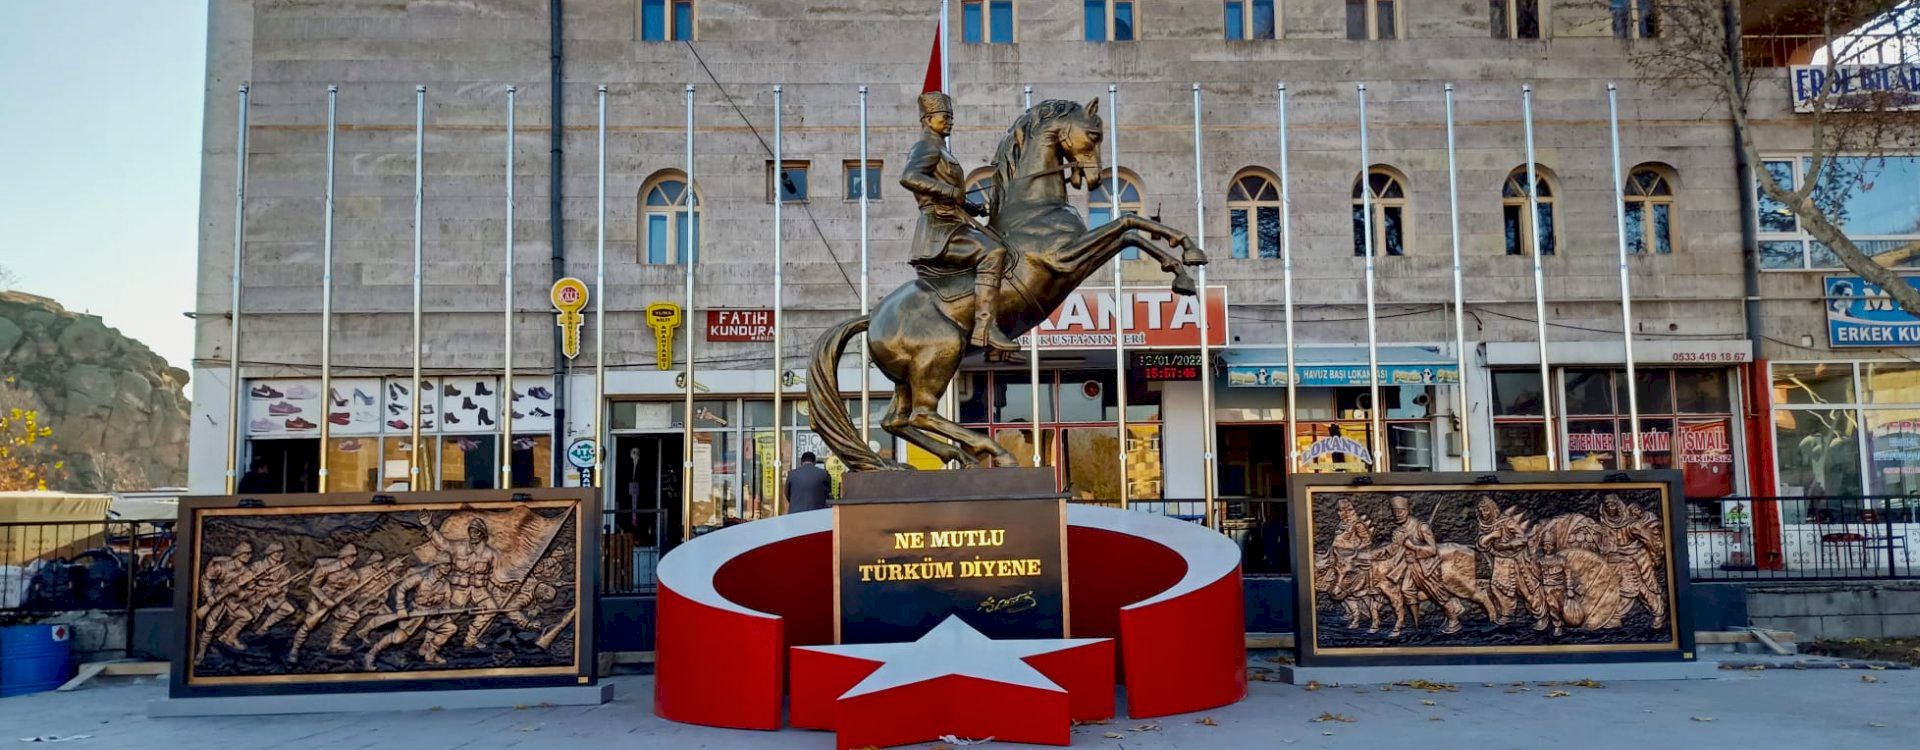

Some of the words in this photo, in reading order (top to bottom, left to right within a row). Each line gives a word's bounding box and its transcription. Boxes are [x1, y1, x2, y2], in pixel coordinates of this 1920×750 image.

[1038, 292, 1209, 331] ANTA
[711, 325, 775, 336] KUNDURA
[1838, 326, 1893, 342] ERKEK
[1673, 353, 1696, 361] 0533
[1699, 353, 1717, 361] 419
[1720, 352, 1731, 361] 18
[1734, 352, 1746, 361] 67
[1304, 369, 1327, 379] HAVUZ
[1329, 369, 1346, 381] BAŞI
[1680, 427, 1729, 450] İSMAİL
[1302, 436, 1372, 464] LOKANTA
[894, 532, 925, 549] NE
[930, 529, 1006, 548] MUTLU
[859, 557, 954, 582] TÜRKÜM
[960, 555, 1042, 578] DİYENE
